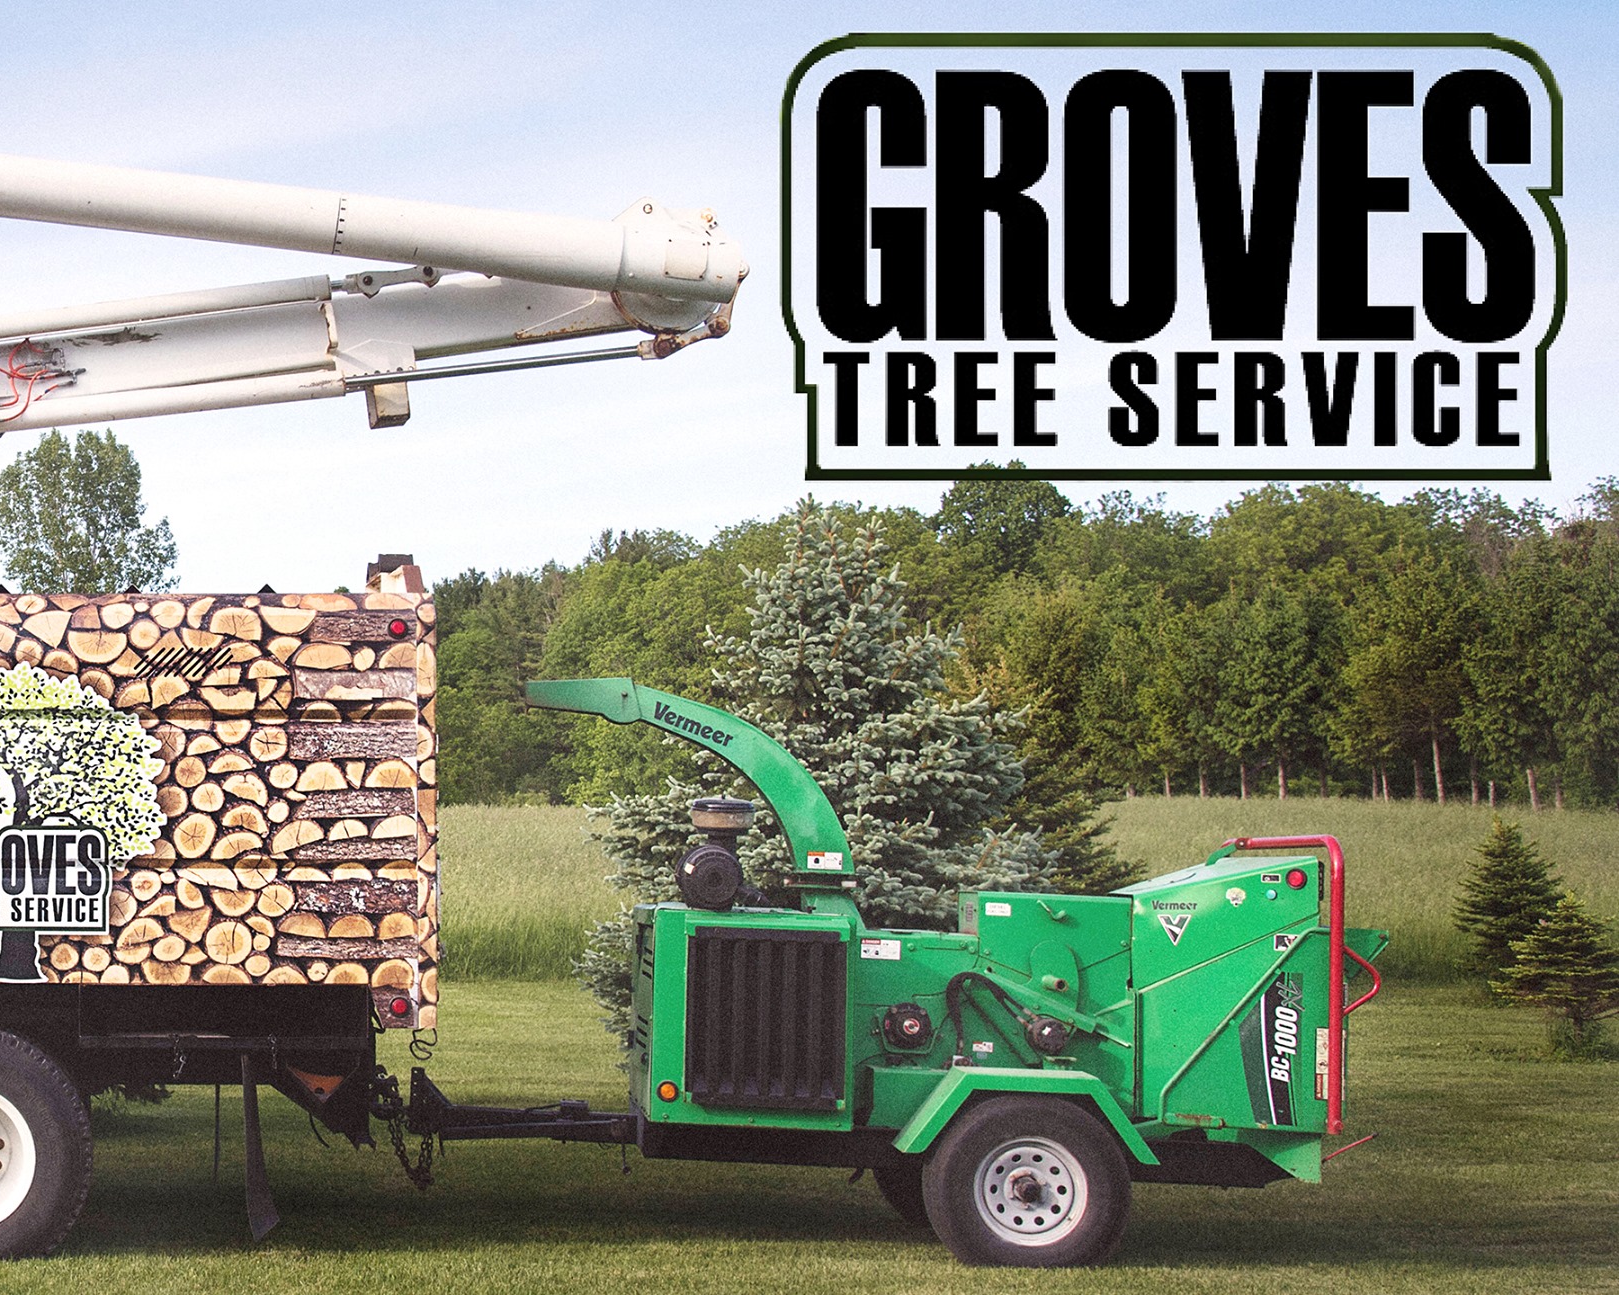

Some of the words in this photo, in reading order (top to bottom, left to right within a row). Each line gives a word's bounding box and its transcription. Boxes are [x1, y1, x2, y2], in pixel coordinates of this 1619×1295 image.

[654, 701, 734, 746] Vermeer
[11, 898, 99, 923] SERVICE
[1152, 900, 1197, 911] Vermeer
